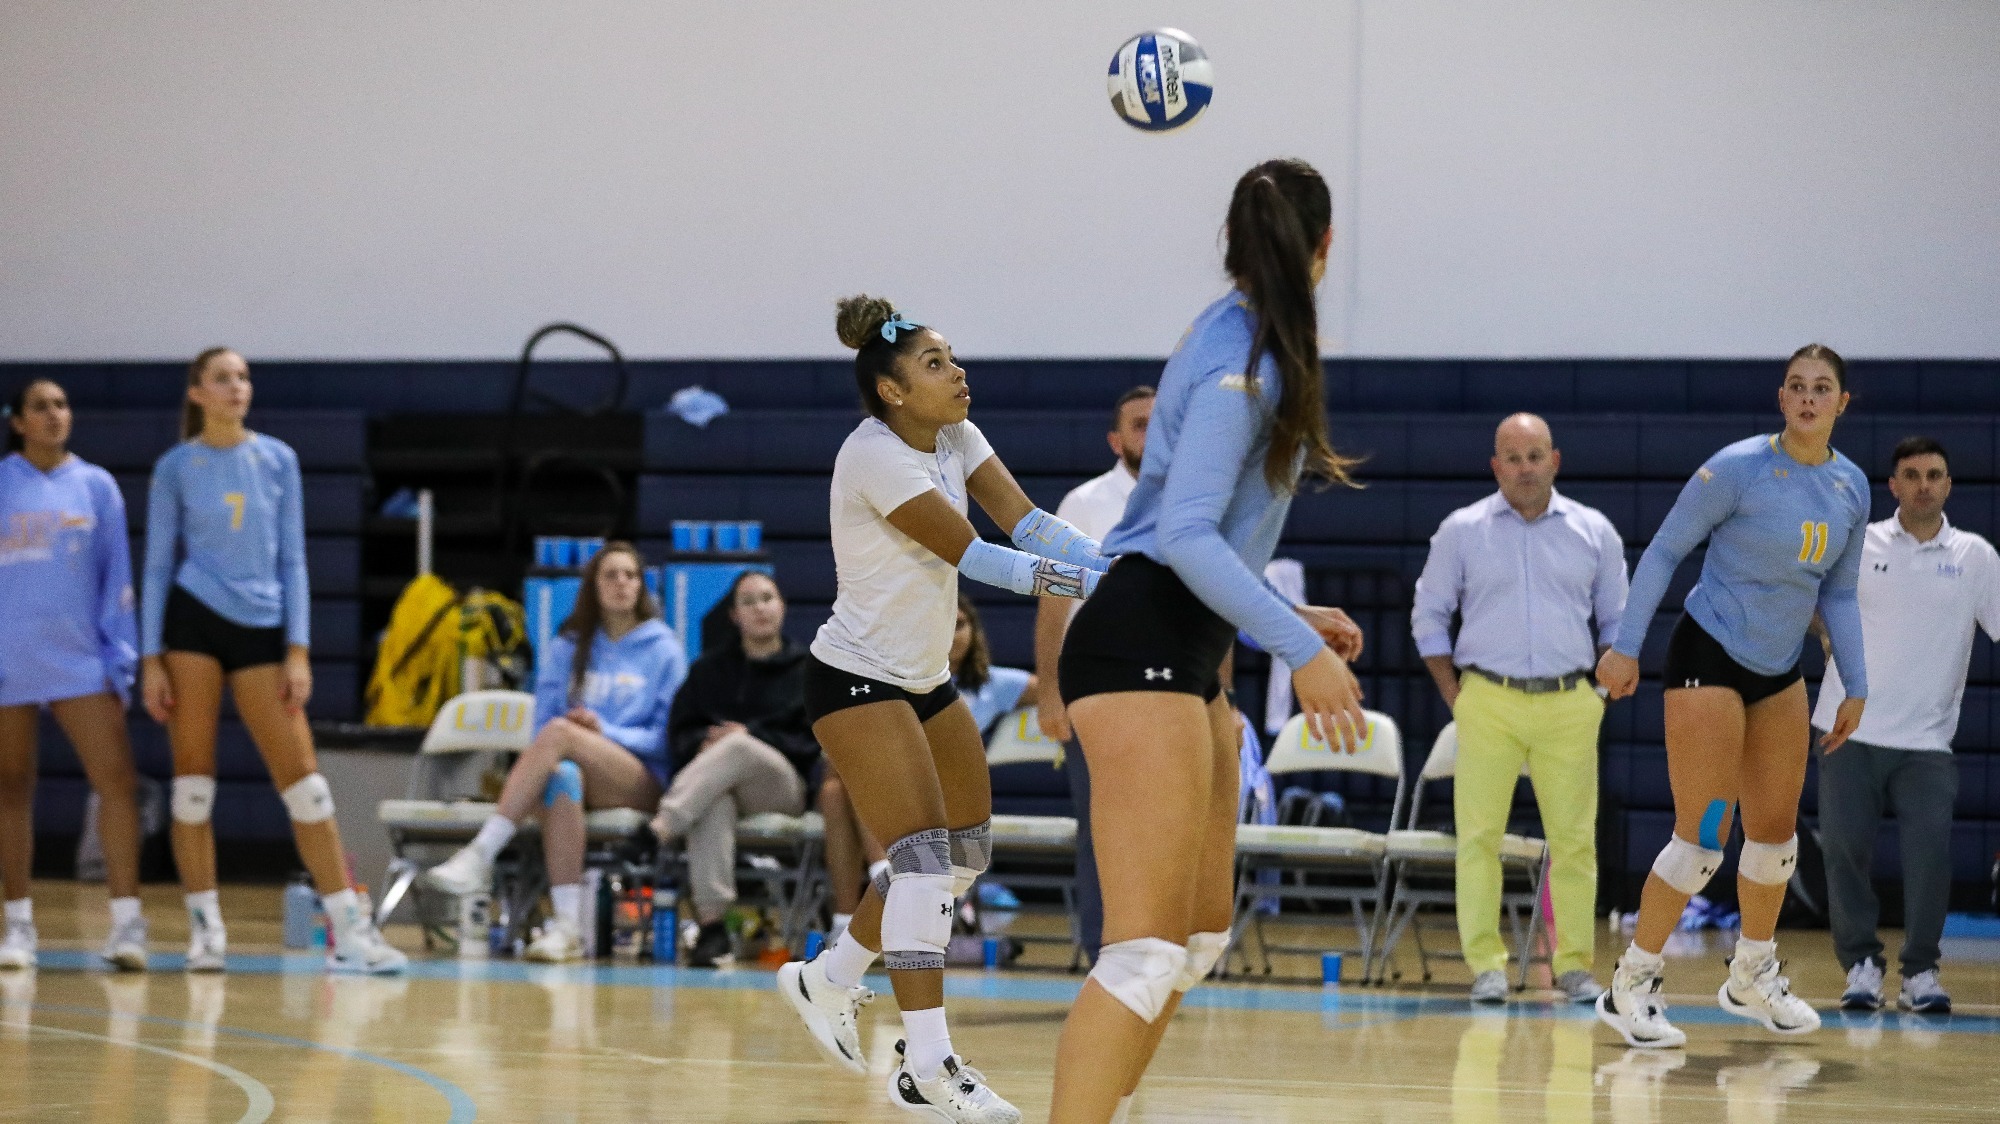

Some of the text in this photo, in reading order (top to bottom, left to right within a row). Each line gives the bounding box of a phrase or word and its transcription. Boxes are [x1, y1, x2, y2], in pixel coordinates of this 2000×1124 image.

[1160, 44, 1180, 105] molten
[223, 491, 246, 533] 7
[1798, 520, 1829, 565] 11
[455, 702, 526, 732] LIU
